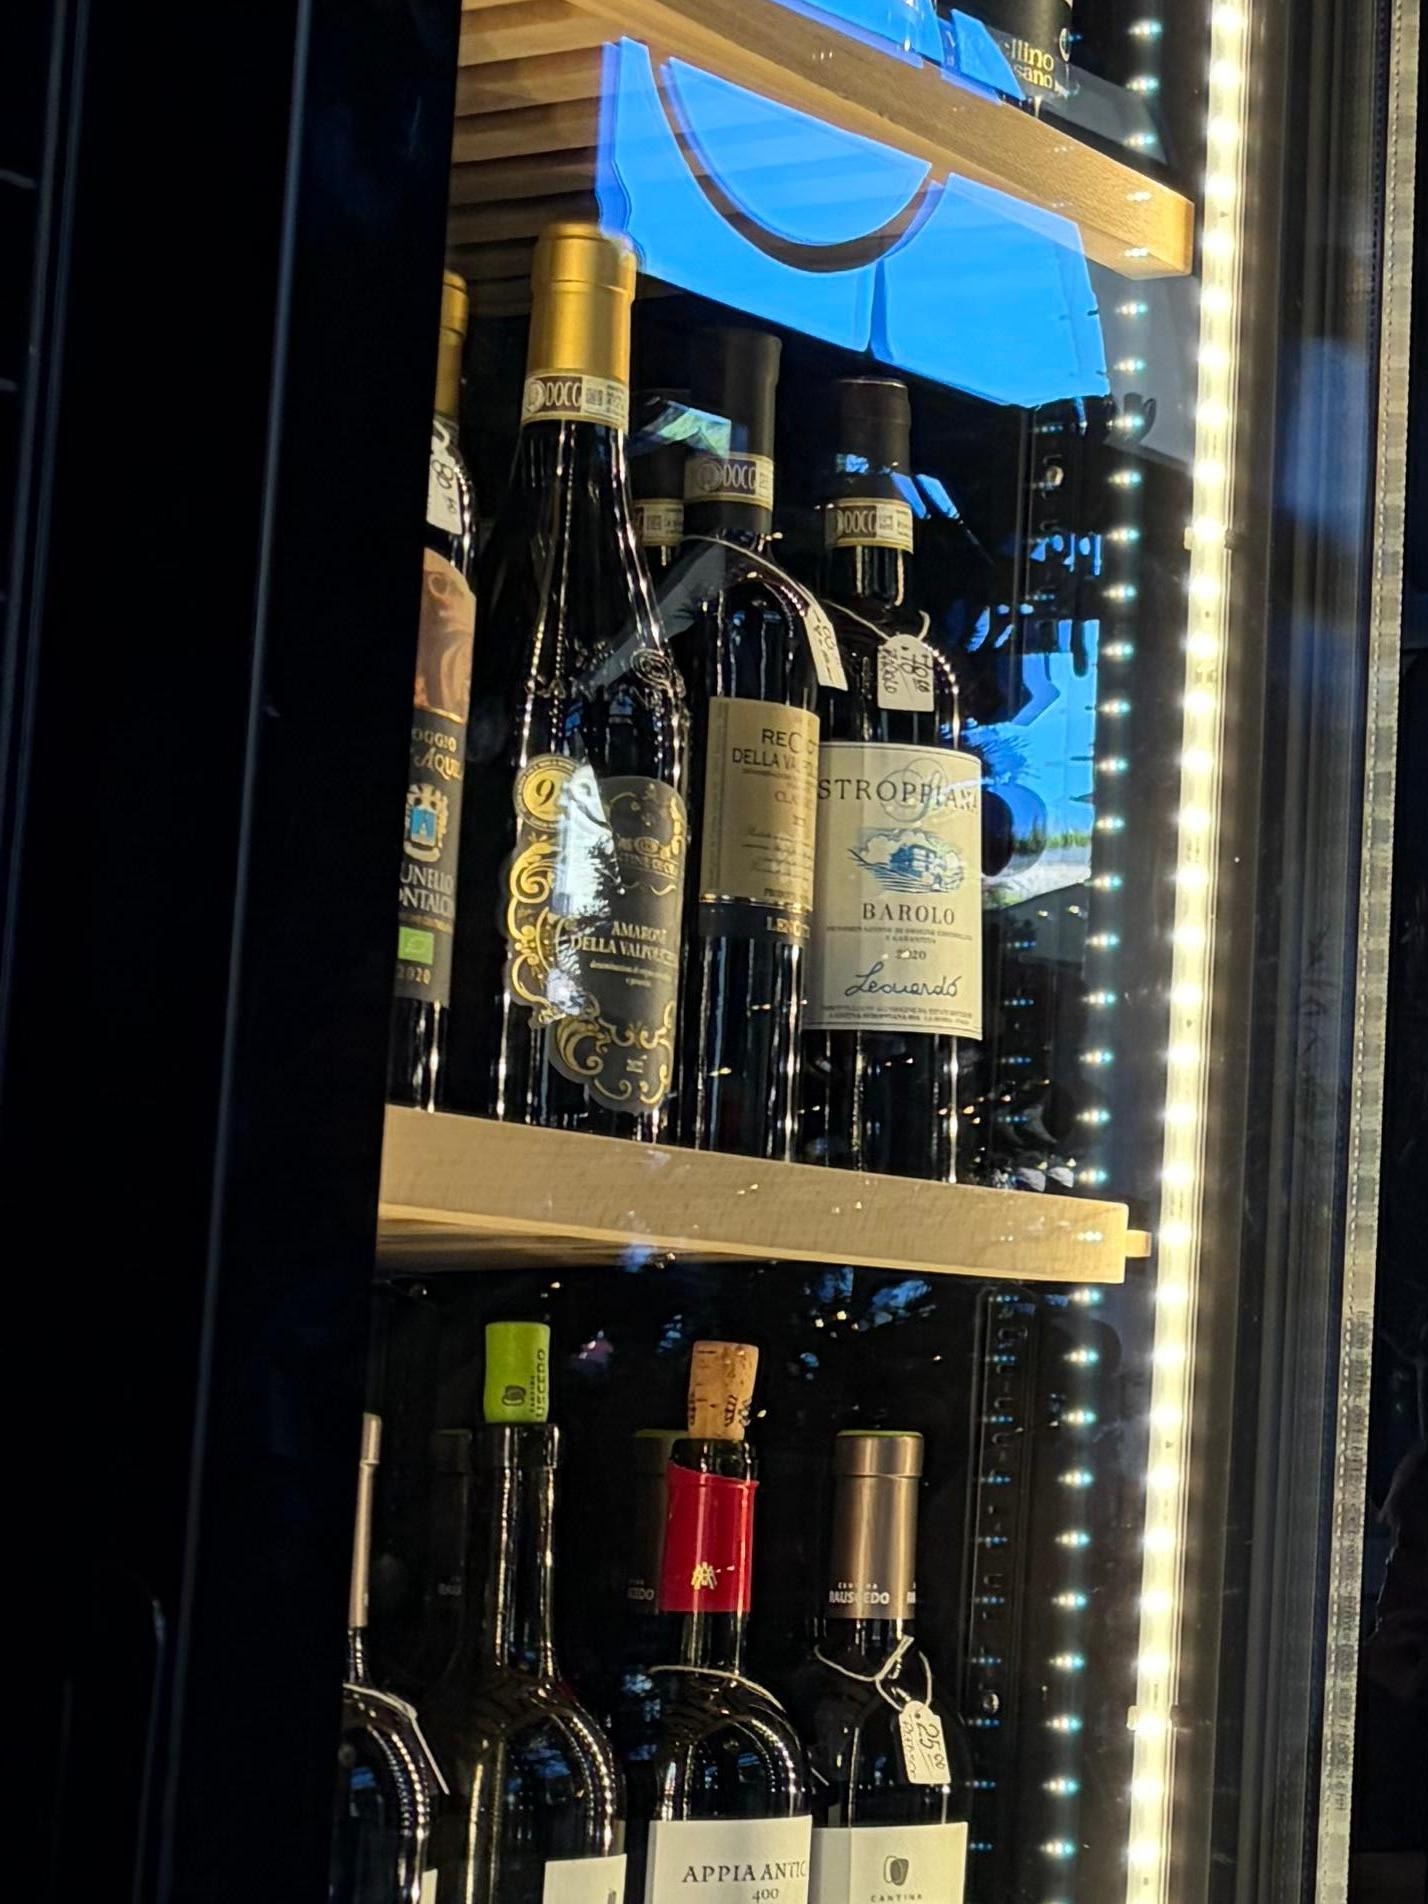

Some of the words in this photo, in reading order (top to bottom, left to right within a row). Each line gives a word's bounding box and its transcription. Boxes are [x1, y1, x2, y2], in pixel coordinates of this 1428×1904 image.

[732, 746, 778, 770] DELLA
[862, 902, 956, 926] BAROLO
[917, 1722, 940, 1749] 25
[681, 1863, 755, 1884] APPIA
[751, 1888, 780, 1904] 400
[870, 1893, 923, 1903] CANTINA
